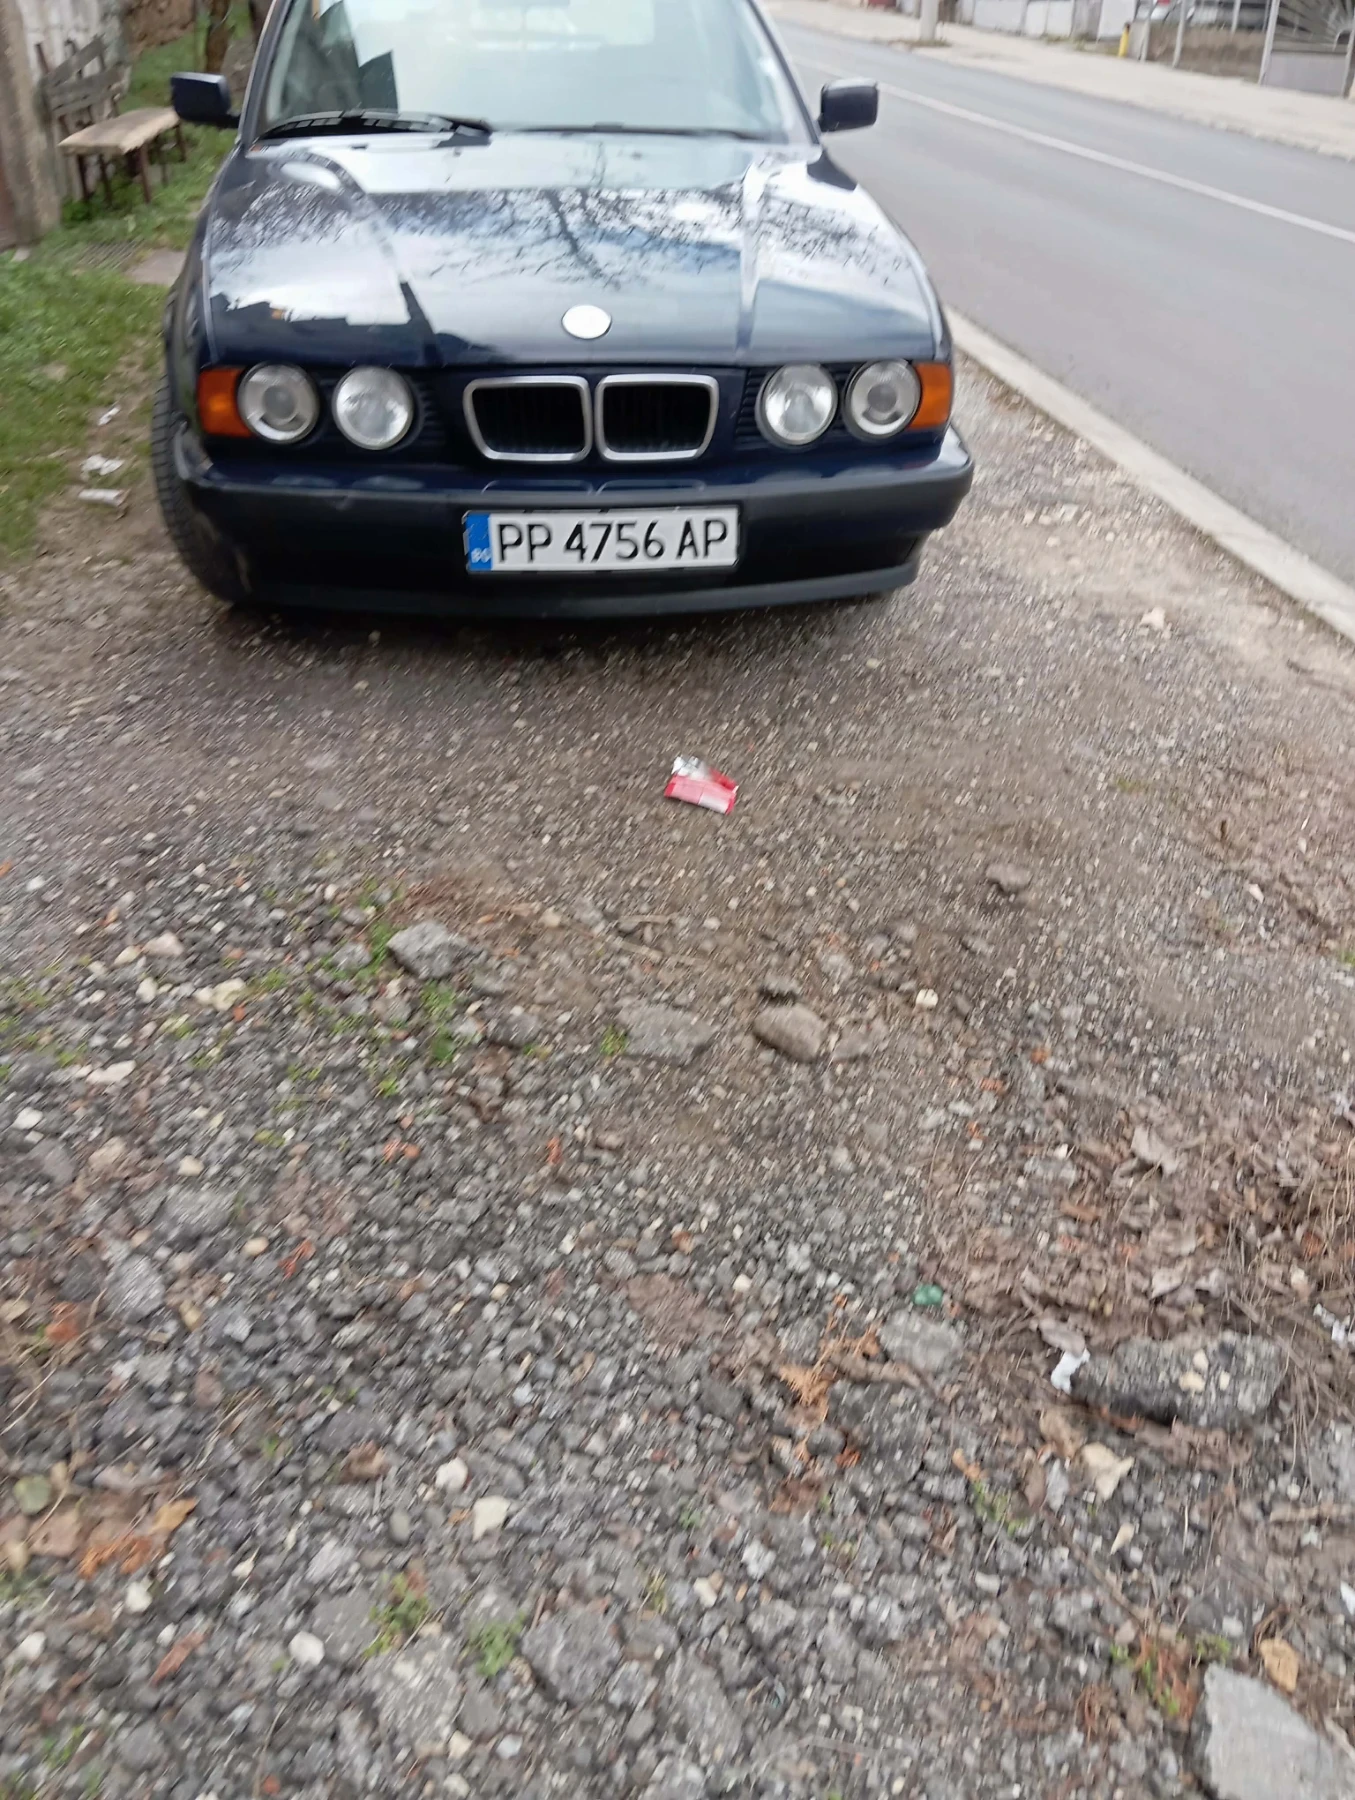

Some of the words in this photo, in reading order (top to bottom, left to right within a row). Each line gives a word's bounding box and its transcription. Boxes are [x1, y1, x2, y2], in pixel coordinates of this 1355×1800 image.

[497, 522, 553, 563] PP
[563, 519, 667, 563] 4756
[675, 517, 728, 560] AP
